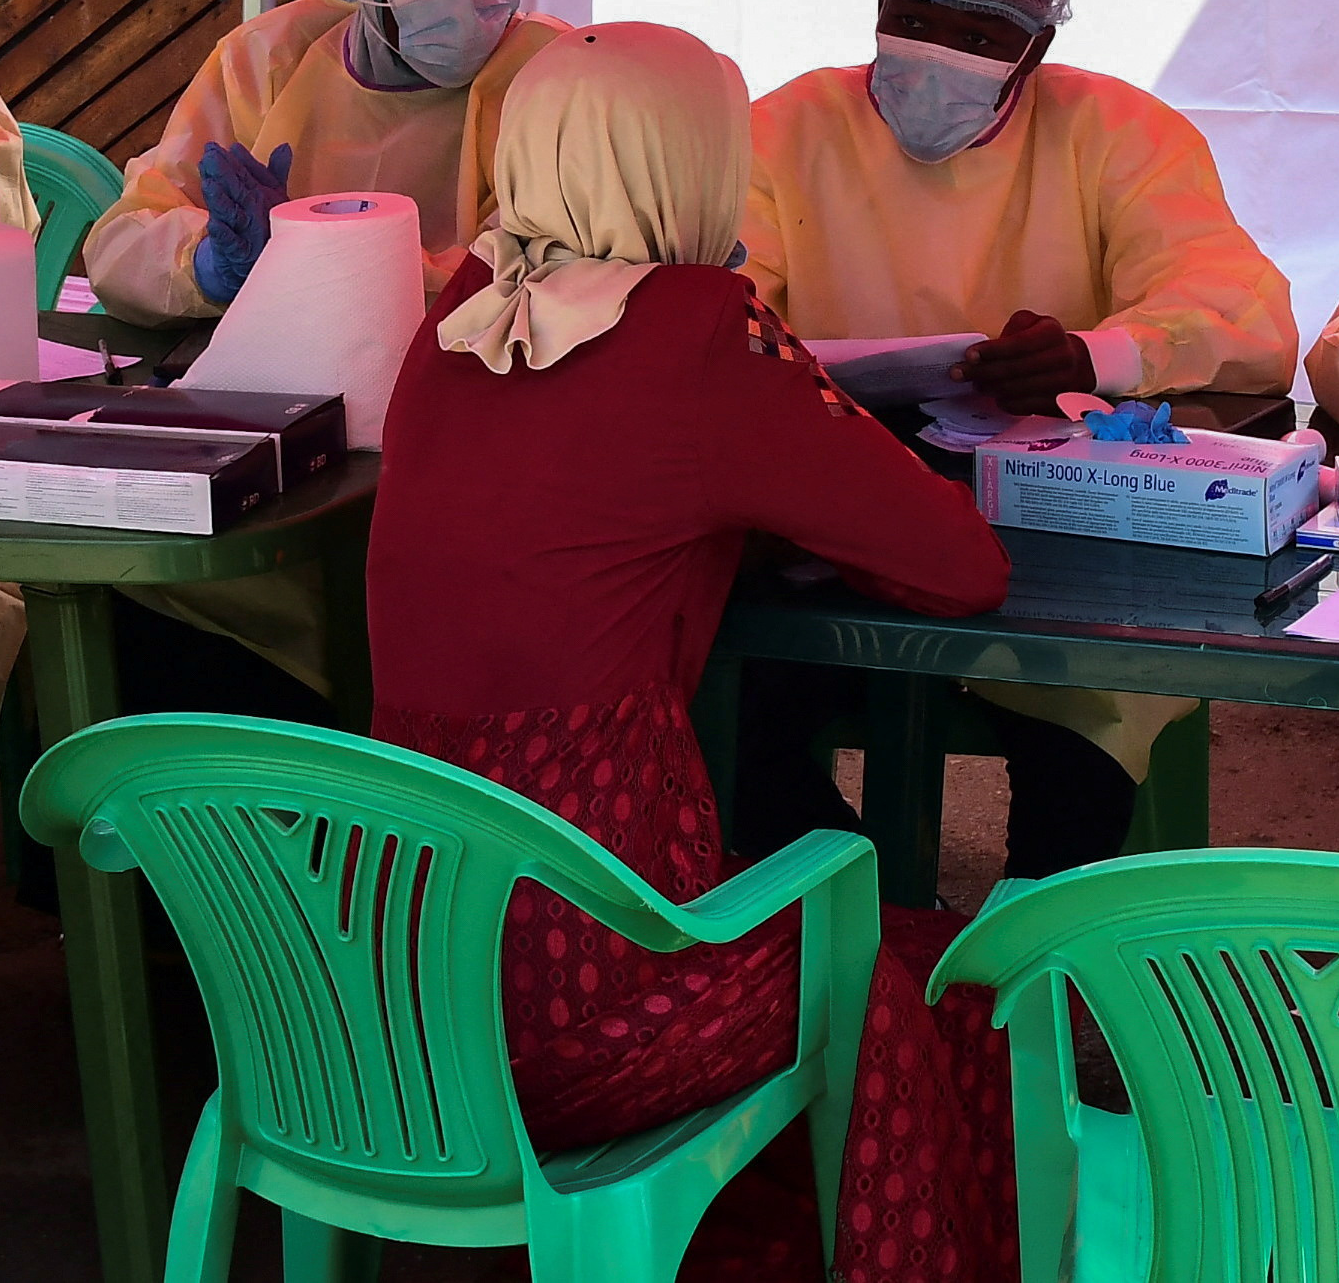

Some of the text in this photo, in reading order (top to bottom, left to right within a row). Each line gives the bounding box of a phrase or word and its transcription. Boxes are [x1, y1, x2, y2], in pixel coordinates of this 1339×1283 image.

[1129, 448, 1183, 466] X-Long
[1047, 464, 1083, 482] 3000
[1087, 468, 1138, 493] X-Long
[1143, 473, 1176, 493] Blue
